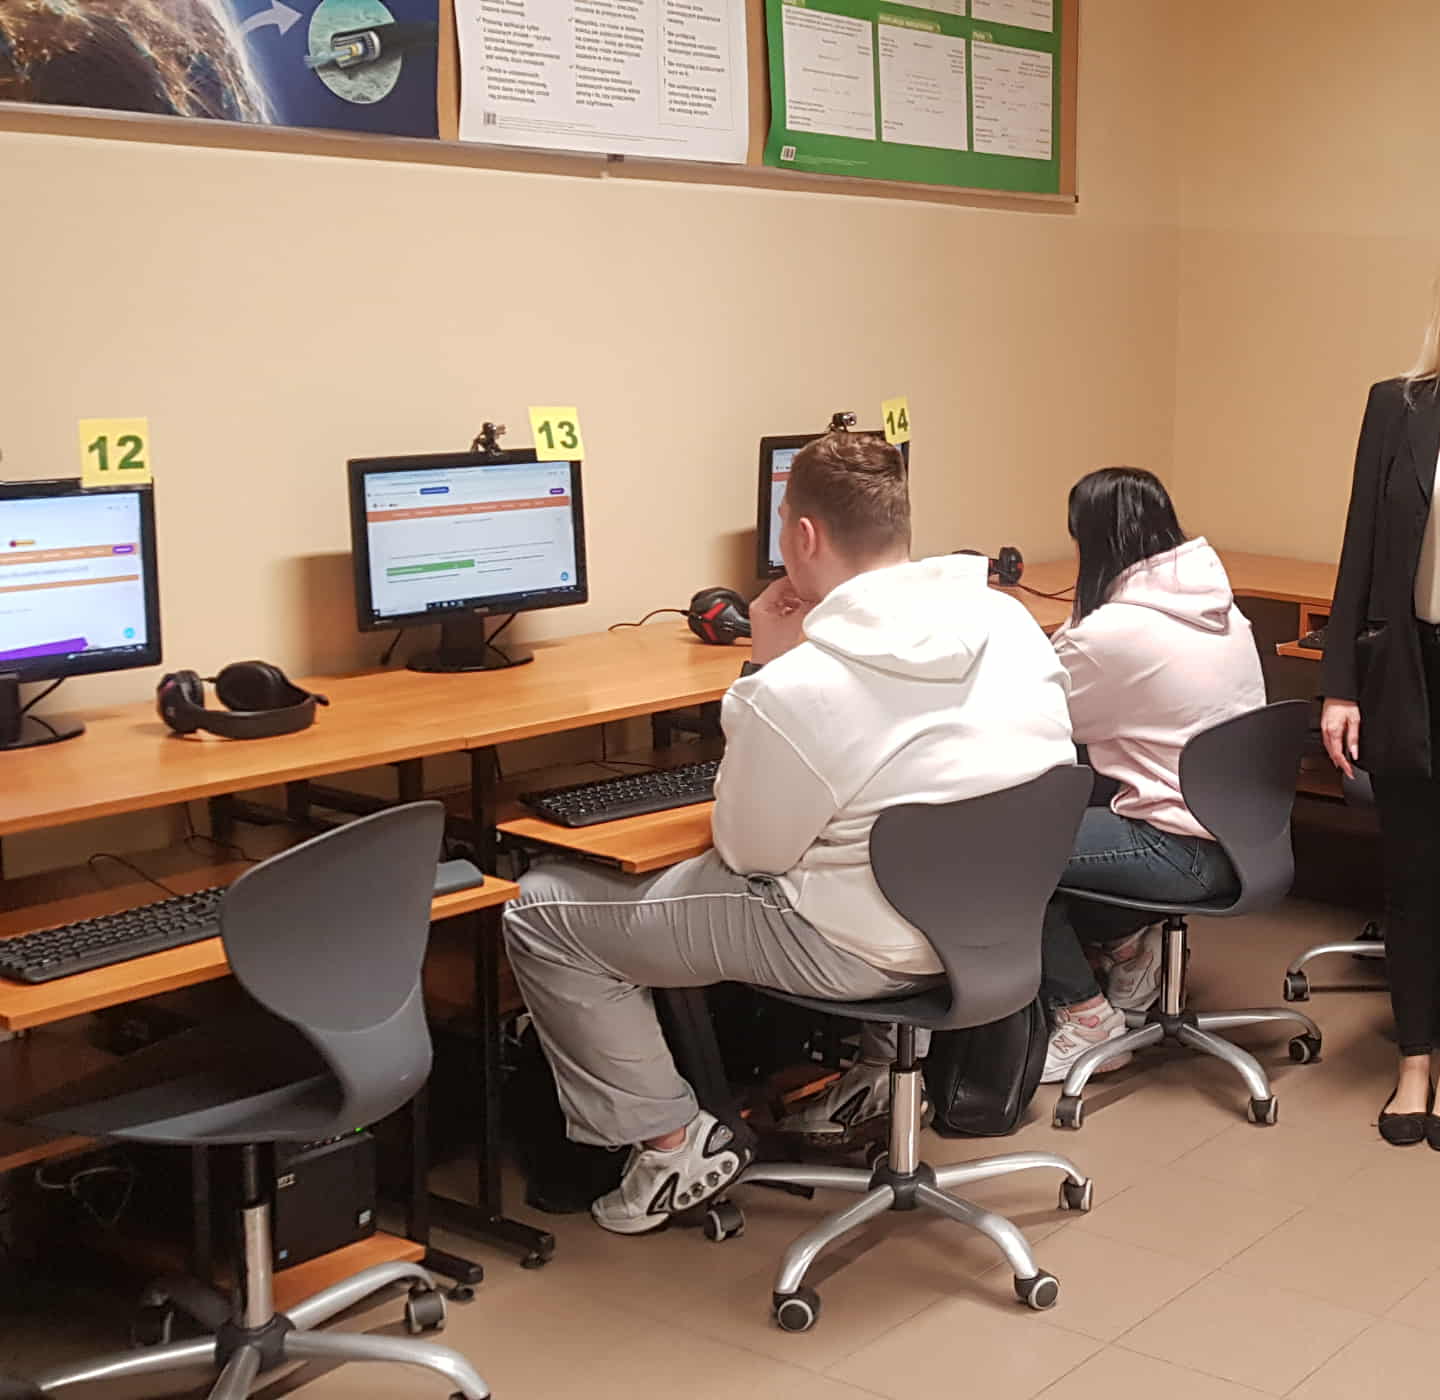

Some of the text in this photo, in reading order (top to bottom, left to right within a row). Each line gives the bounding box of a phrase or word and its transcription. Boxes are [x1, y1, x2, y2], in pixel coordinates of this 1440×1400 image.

[538, 420, 578, 449] 13
[886, 408, 908, 435] 14
[88, 435, 144, 470] 12
